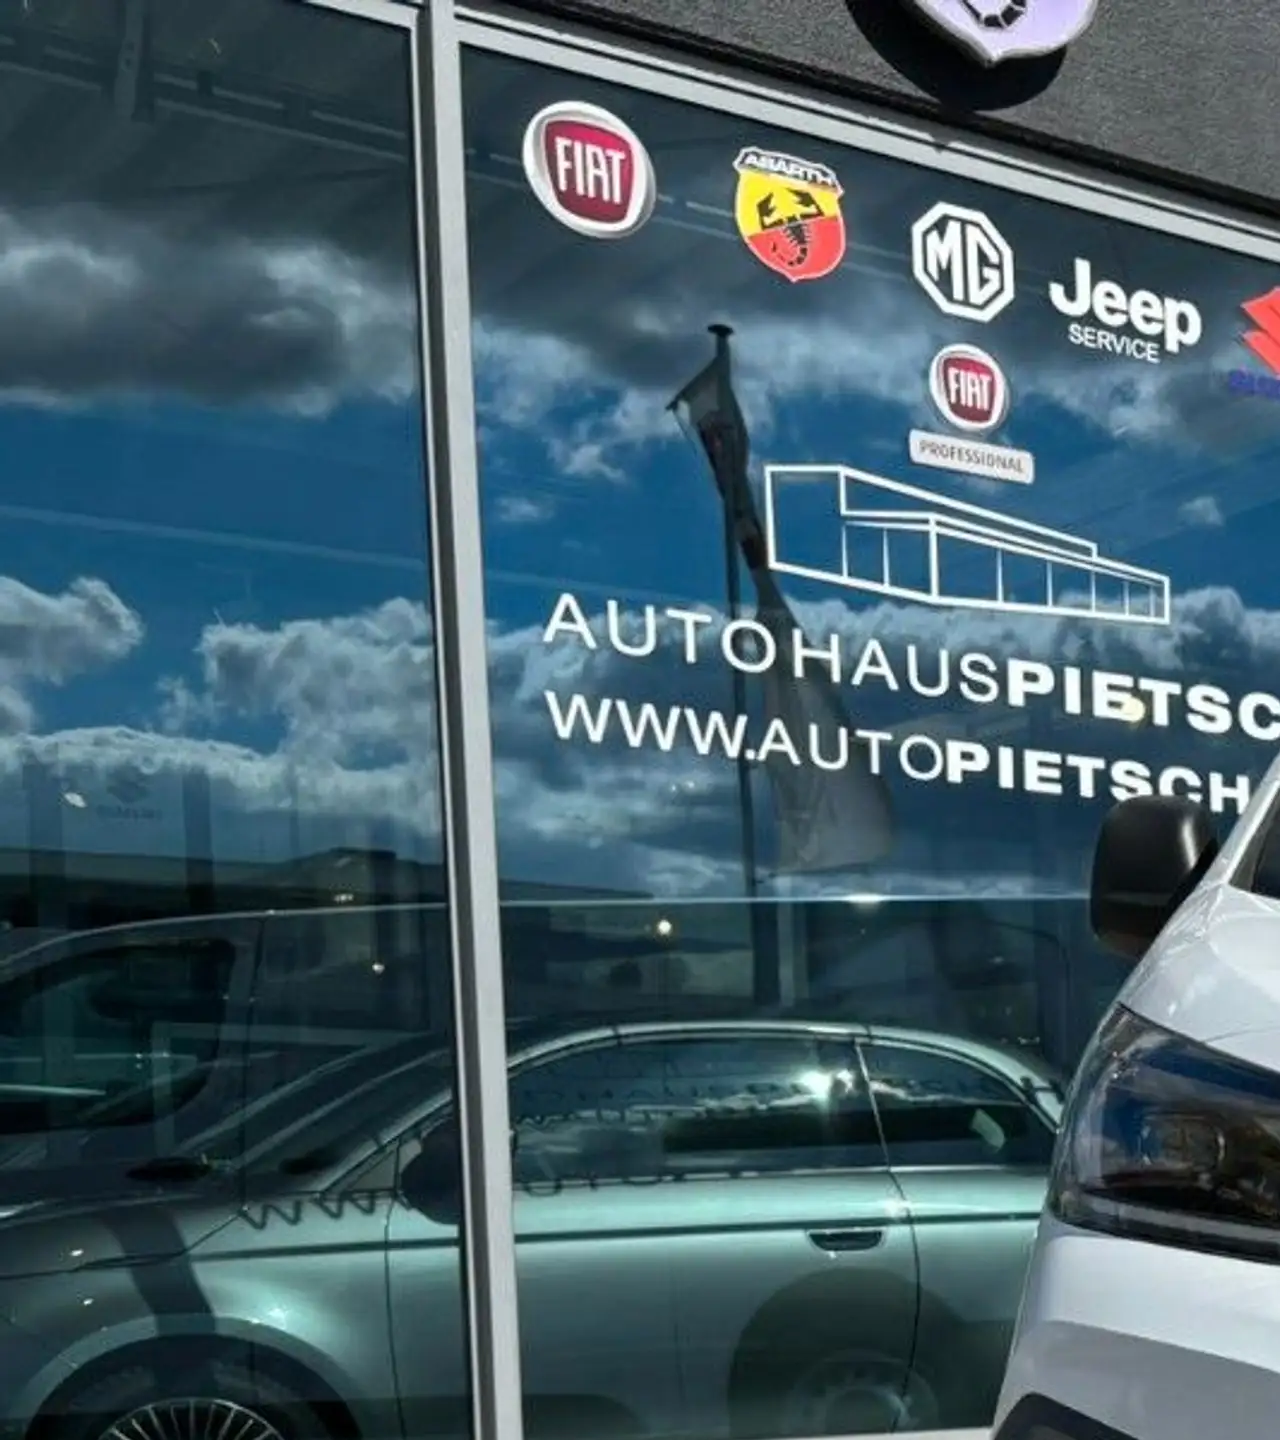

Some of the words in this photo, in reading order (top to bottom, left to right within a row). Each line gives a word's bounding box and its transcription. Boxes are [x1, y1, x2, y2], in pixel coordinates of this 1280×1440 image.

[555, 136, 626, 205] FIAT
[925, 218, 1001, 306] MG
[1049, 257, 1202, 354] Jeep
[1068, 323, 1161, 365] SERVICE
[948, 366, 993, 412] FIAT
[918, 439, 1026, 474] PROFESSIONAL
